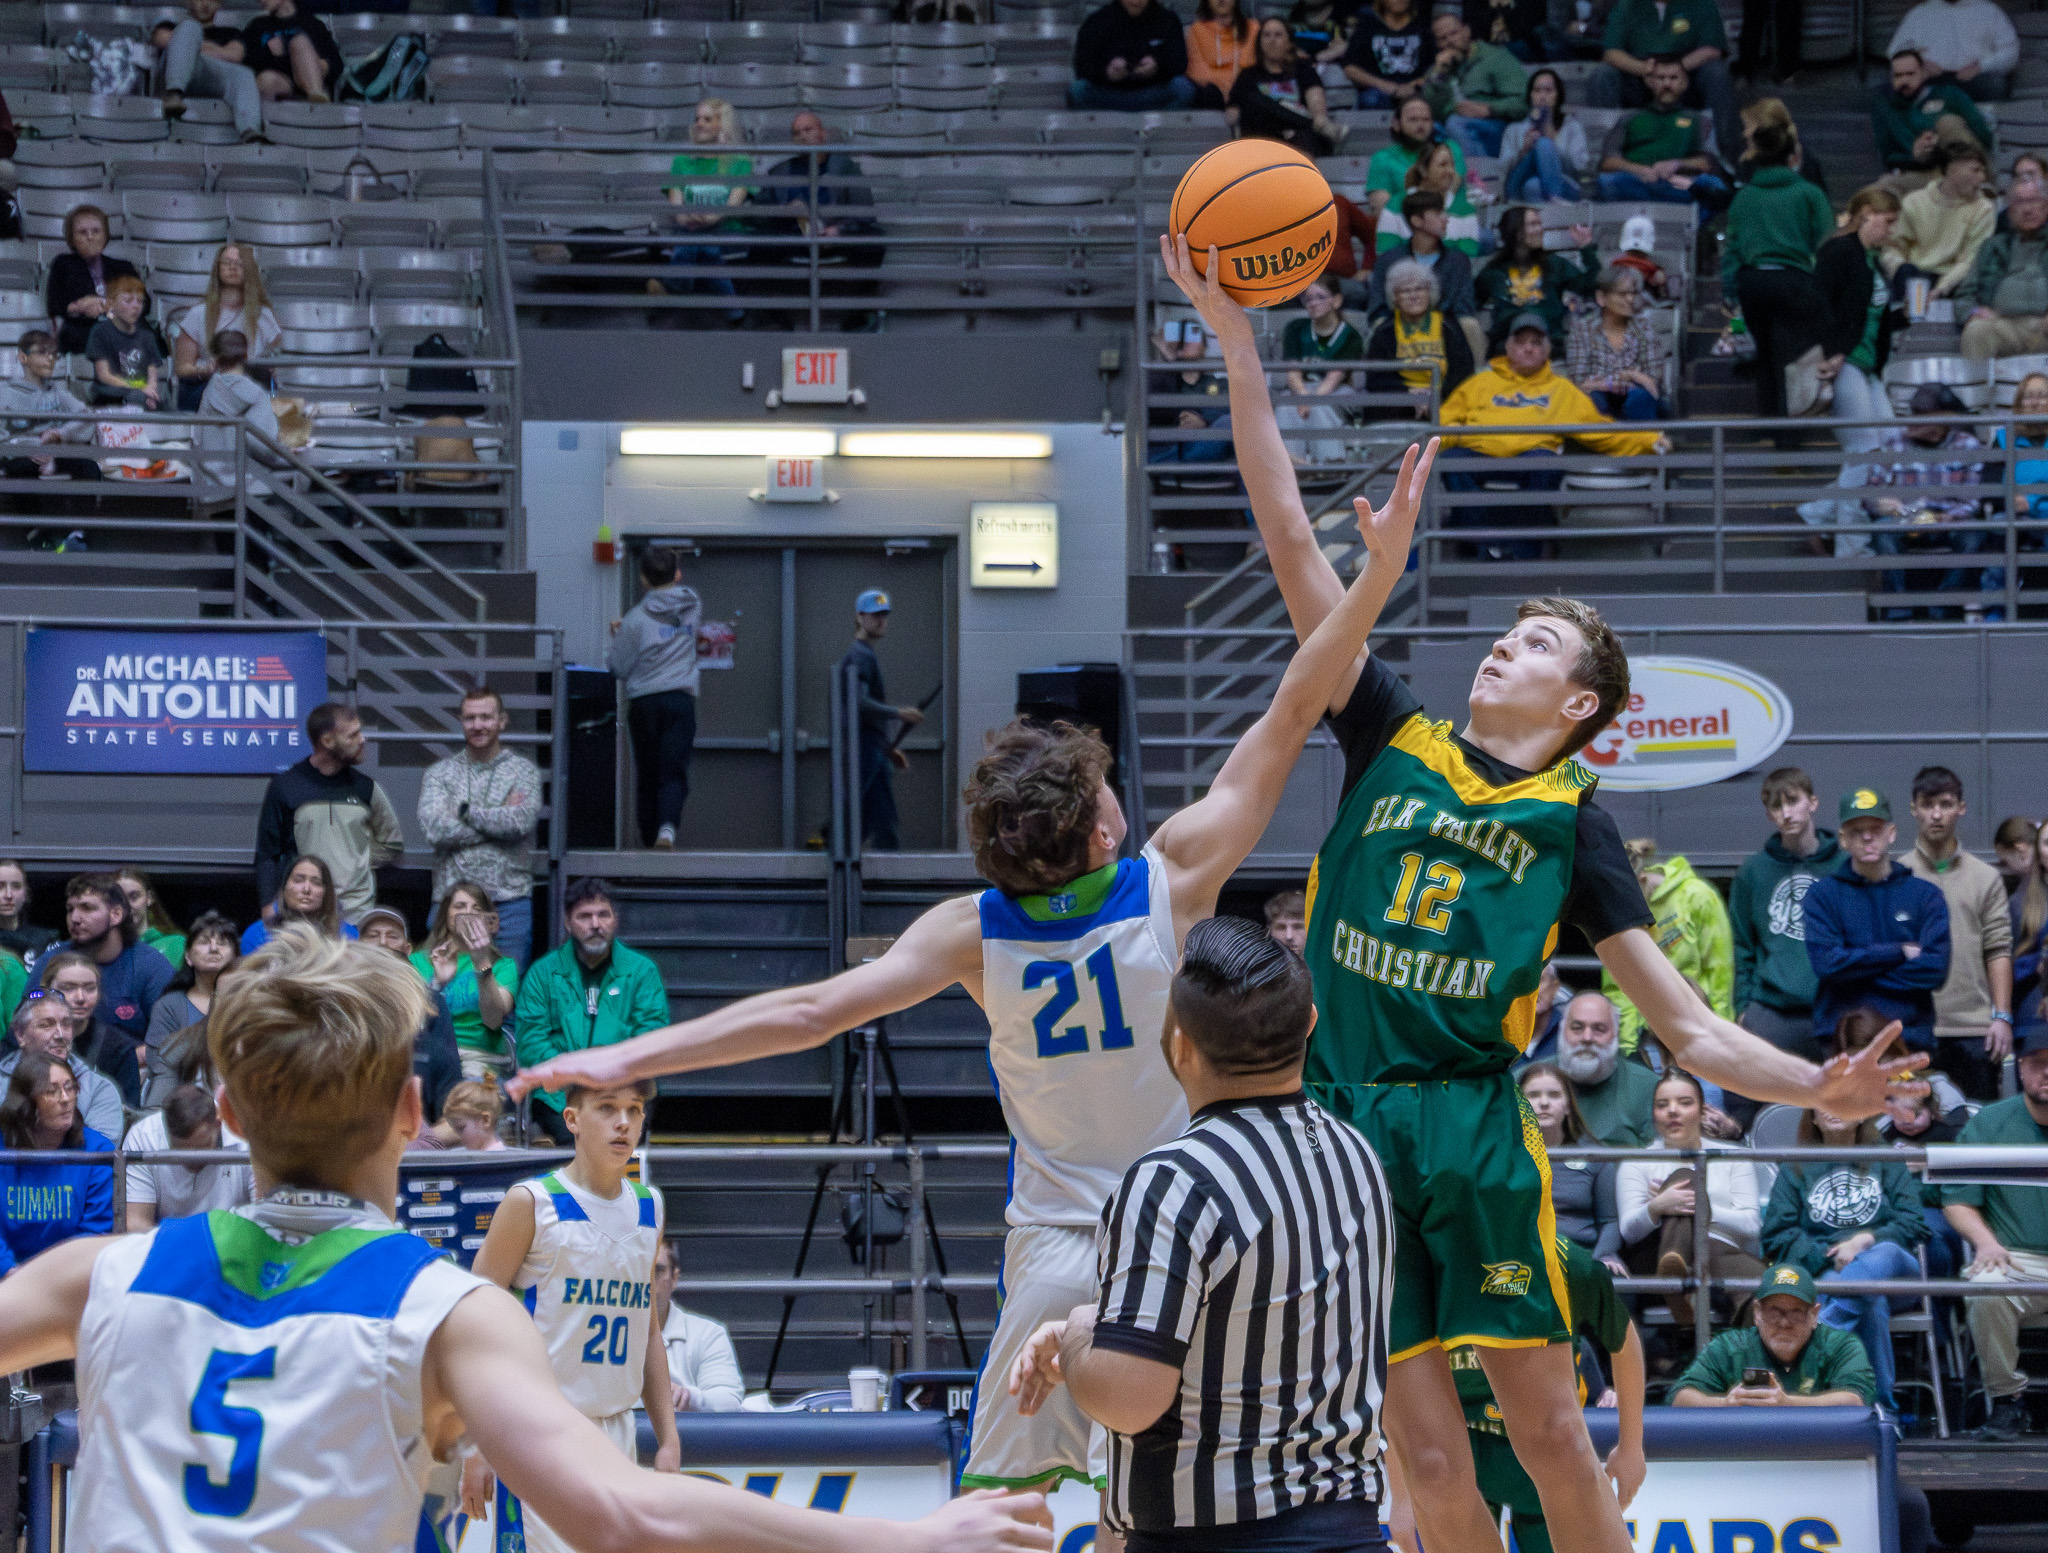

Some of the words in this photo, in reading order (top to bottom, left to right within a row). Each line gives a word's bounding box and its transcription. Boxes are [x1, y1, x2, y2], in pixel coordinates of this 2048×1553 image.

[1231, 229, 1332, 281] Wilson
[795, 353, 838, 385] EXIT
[777, 460, 813, 487] EXIT
[977, 518, 1053, 534] Refreshments
[76, 667, 101, 681] DR.
[103, 655, 246, 681] MICHAEL
[66, 682, 296, 719] ANTOLINI
[67, 729, 157, 745] STATE
[182, 730, 299, 746] SENATE
[1362, 796, 1426, 837] ELK
[1429, 811, 1537, 884] VALLEY
[1384, 852, 1465, 935] 12
[1332, 919, 1495, 998] CHRISTIAN
[1022, 942, 1134, 1058] 21
[7, 1185, 73, 1220] SUMMIT
[562, 1277, 651, 1309] FALCONS
[581, 1314, 628, 1366] 20
[1449, 1351, 1480, 1370] LK
[182, 1345, 278, 1519] 5
